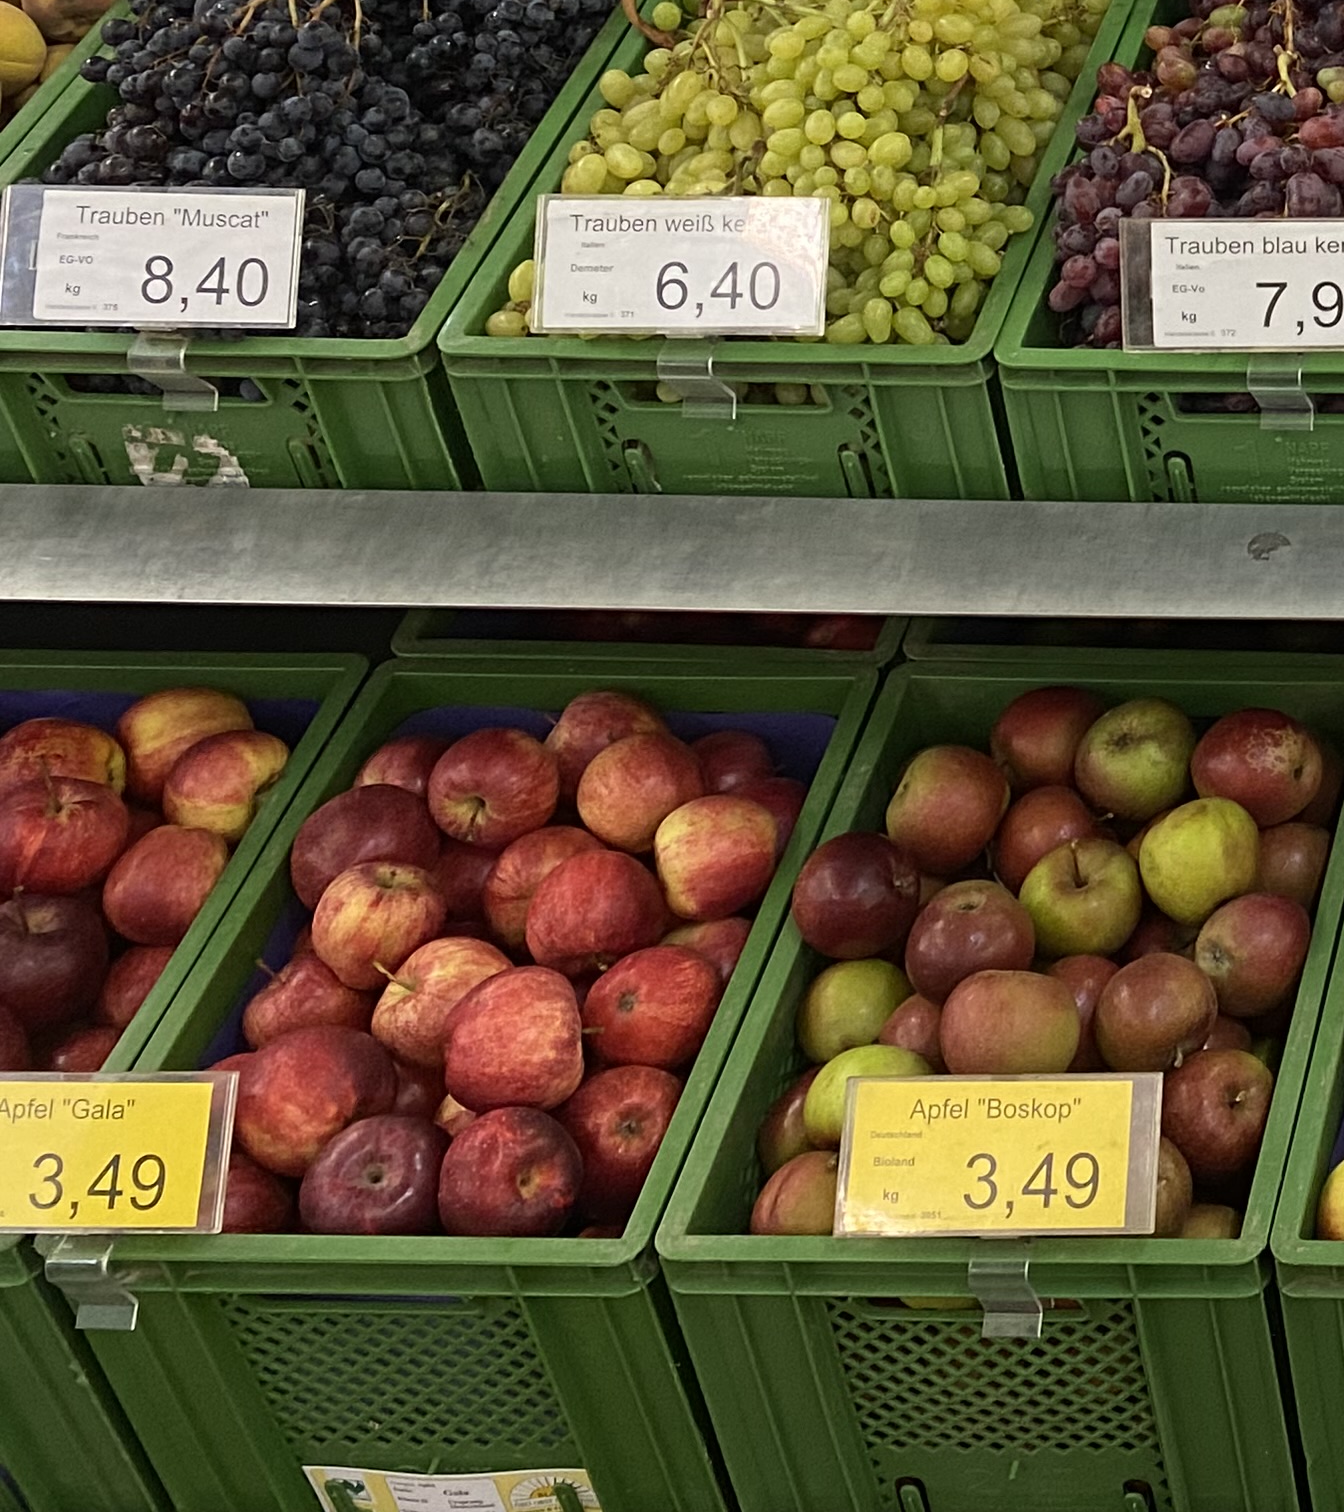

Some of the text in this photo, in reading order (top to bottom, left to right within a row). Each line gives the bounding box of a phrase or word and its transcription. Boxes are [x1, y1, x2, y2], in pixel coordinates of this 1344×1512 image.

[76, 205, 269, 229] Trauben "Muscat"
[569, 214, 657, 233] Trauben
[664, 214, 715, 232] weiß
[1164, 236, 1254, 255] Trauben
[1262, 236, 1307, 254] blau
[59, 254, 94, 265] EG-VO
[570, 263, 614, 274] Demeter
[64, 283, 81, 296] kg
[141, 255, 269, 313] 8,40
[655, 261, 781, 318] 6,40
[1172, 284, 1205, 294] EG-Vo
[582, 290, 598, 304] kg
[1181, 310, 1197, 324] kg
[0, 1098, 136, 1123] Apfel "Gala"
[909, 1097, 1082, 1124] Apfel "Boskop"
[873, 1155, 916, 1167] Bioland
[29, 1153, 166, 1220] 3,49
[963, 1151, 1100, 1219] 3,49
[882, 1188, 899, 1203] kg
